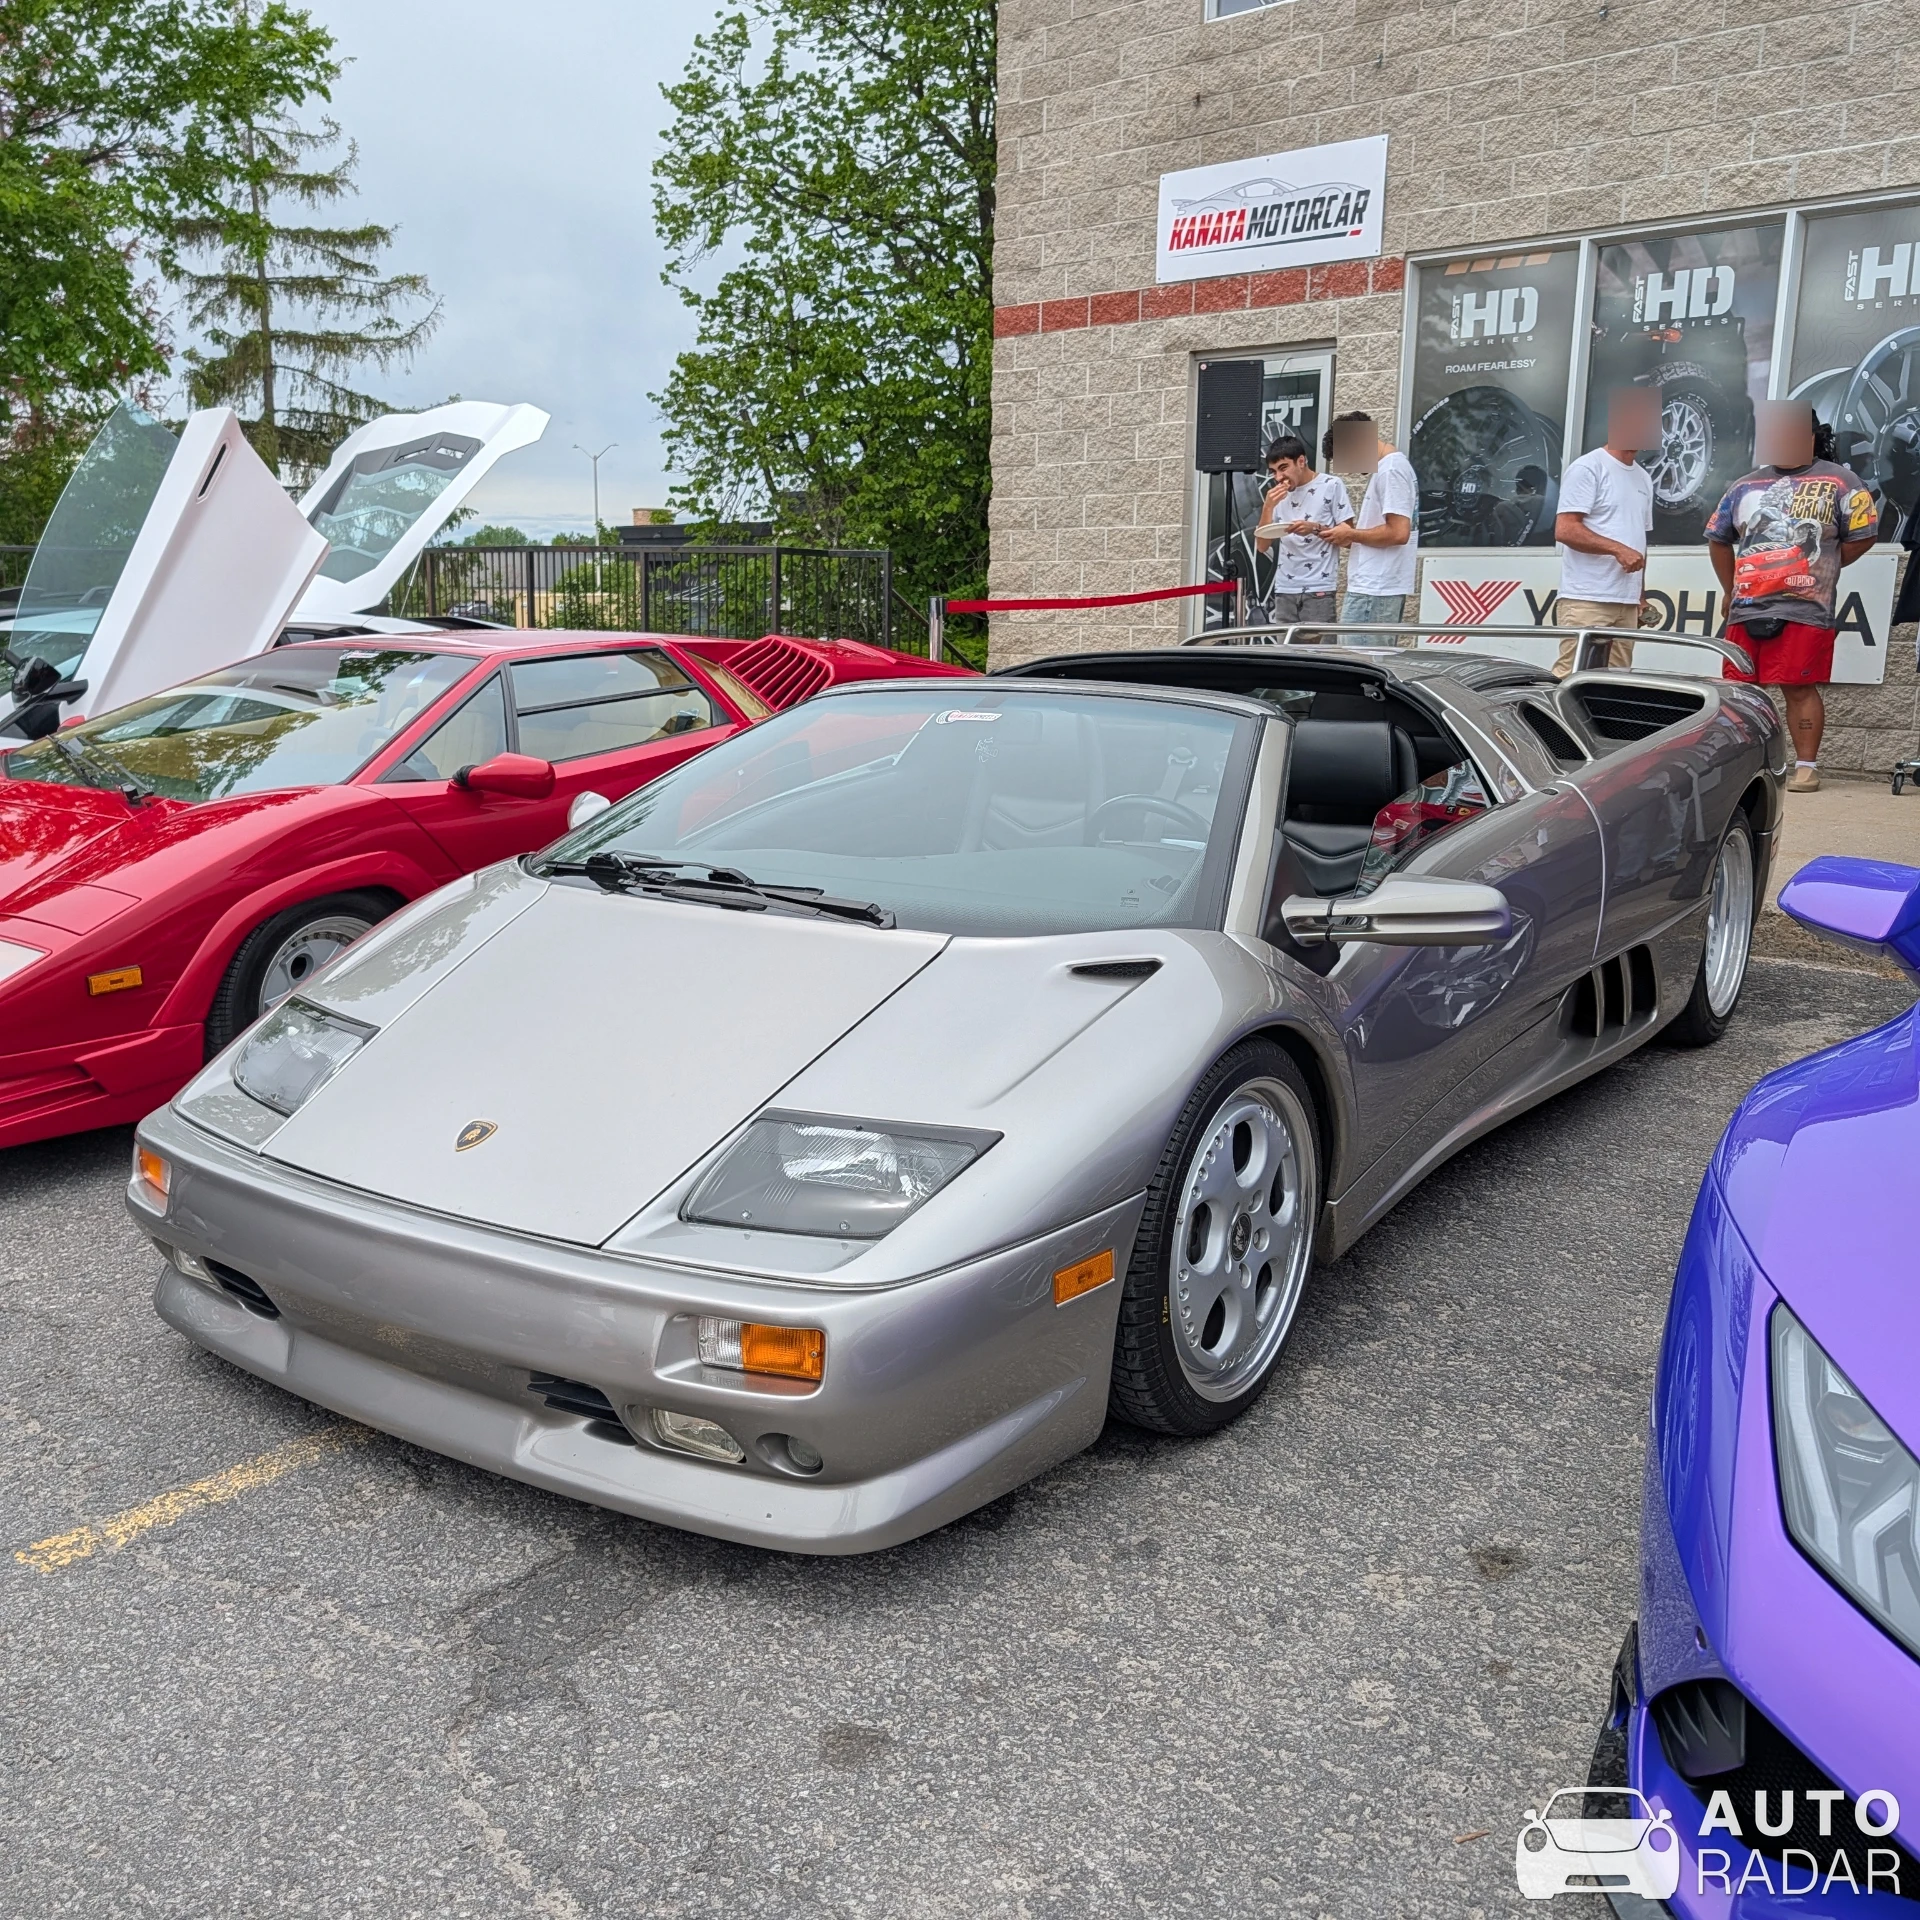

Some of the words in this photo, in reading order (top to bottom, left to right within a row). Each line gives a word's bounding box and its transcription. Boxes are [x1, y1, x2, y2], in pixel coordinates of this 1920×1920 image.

[1644, 265, 1735, 322] HD
[1844, 250, 1859, 301] FAST
[1858, 241, 1920, 300] H
[1450, 295, 1461, 339] FAST
[1460, 286, 1539, 339] HD
[1632, 275, 1645, 323] FAST
[1460, 335, 1534, 347] SERIES
[1643, 318, 1728, 331] SERIES
[1445, 363, 1476, 374] ROAM
[1477, 358, 1537, 371] FEARLESSY
[1461, 482, 1476, 494] HD
